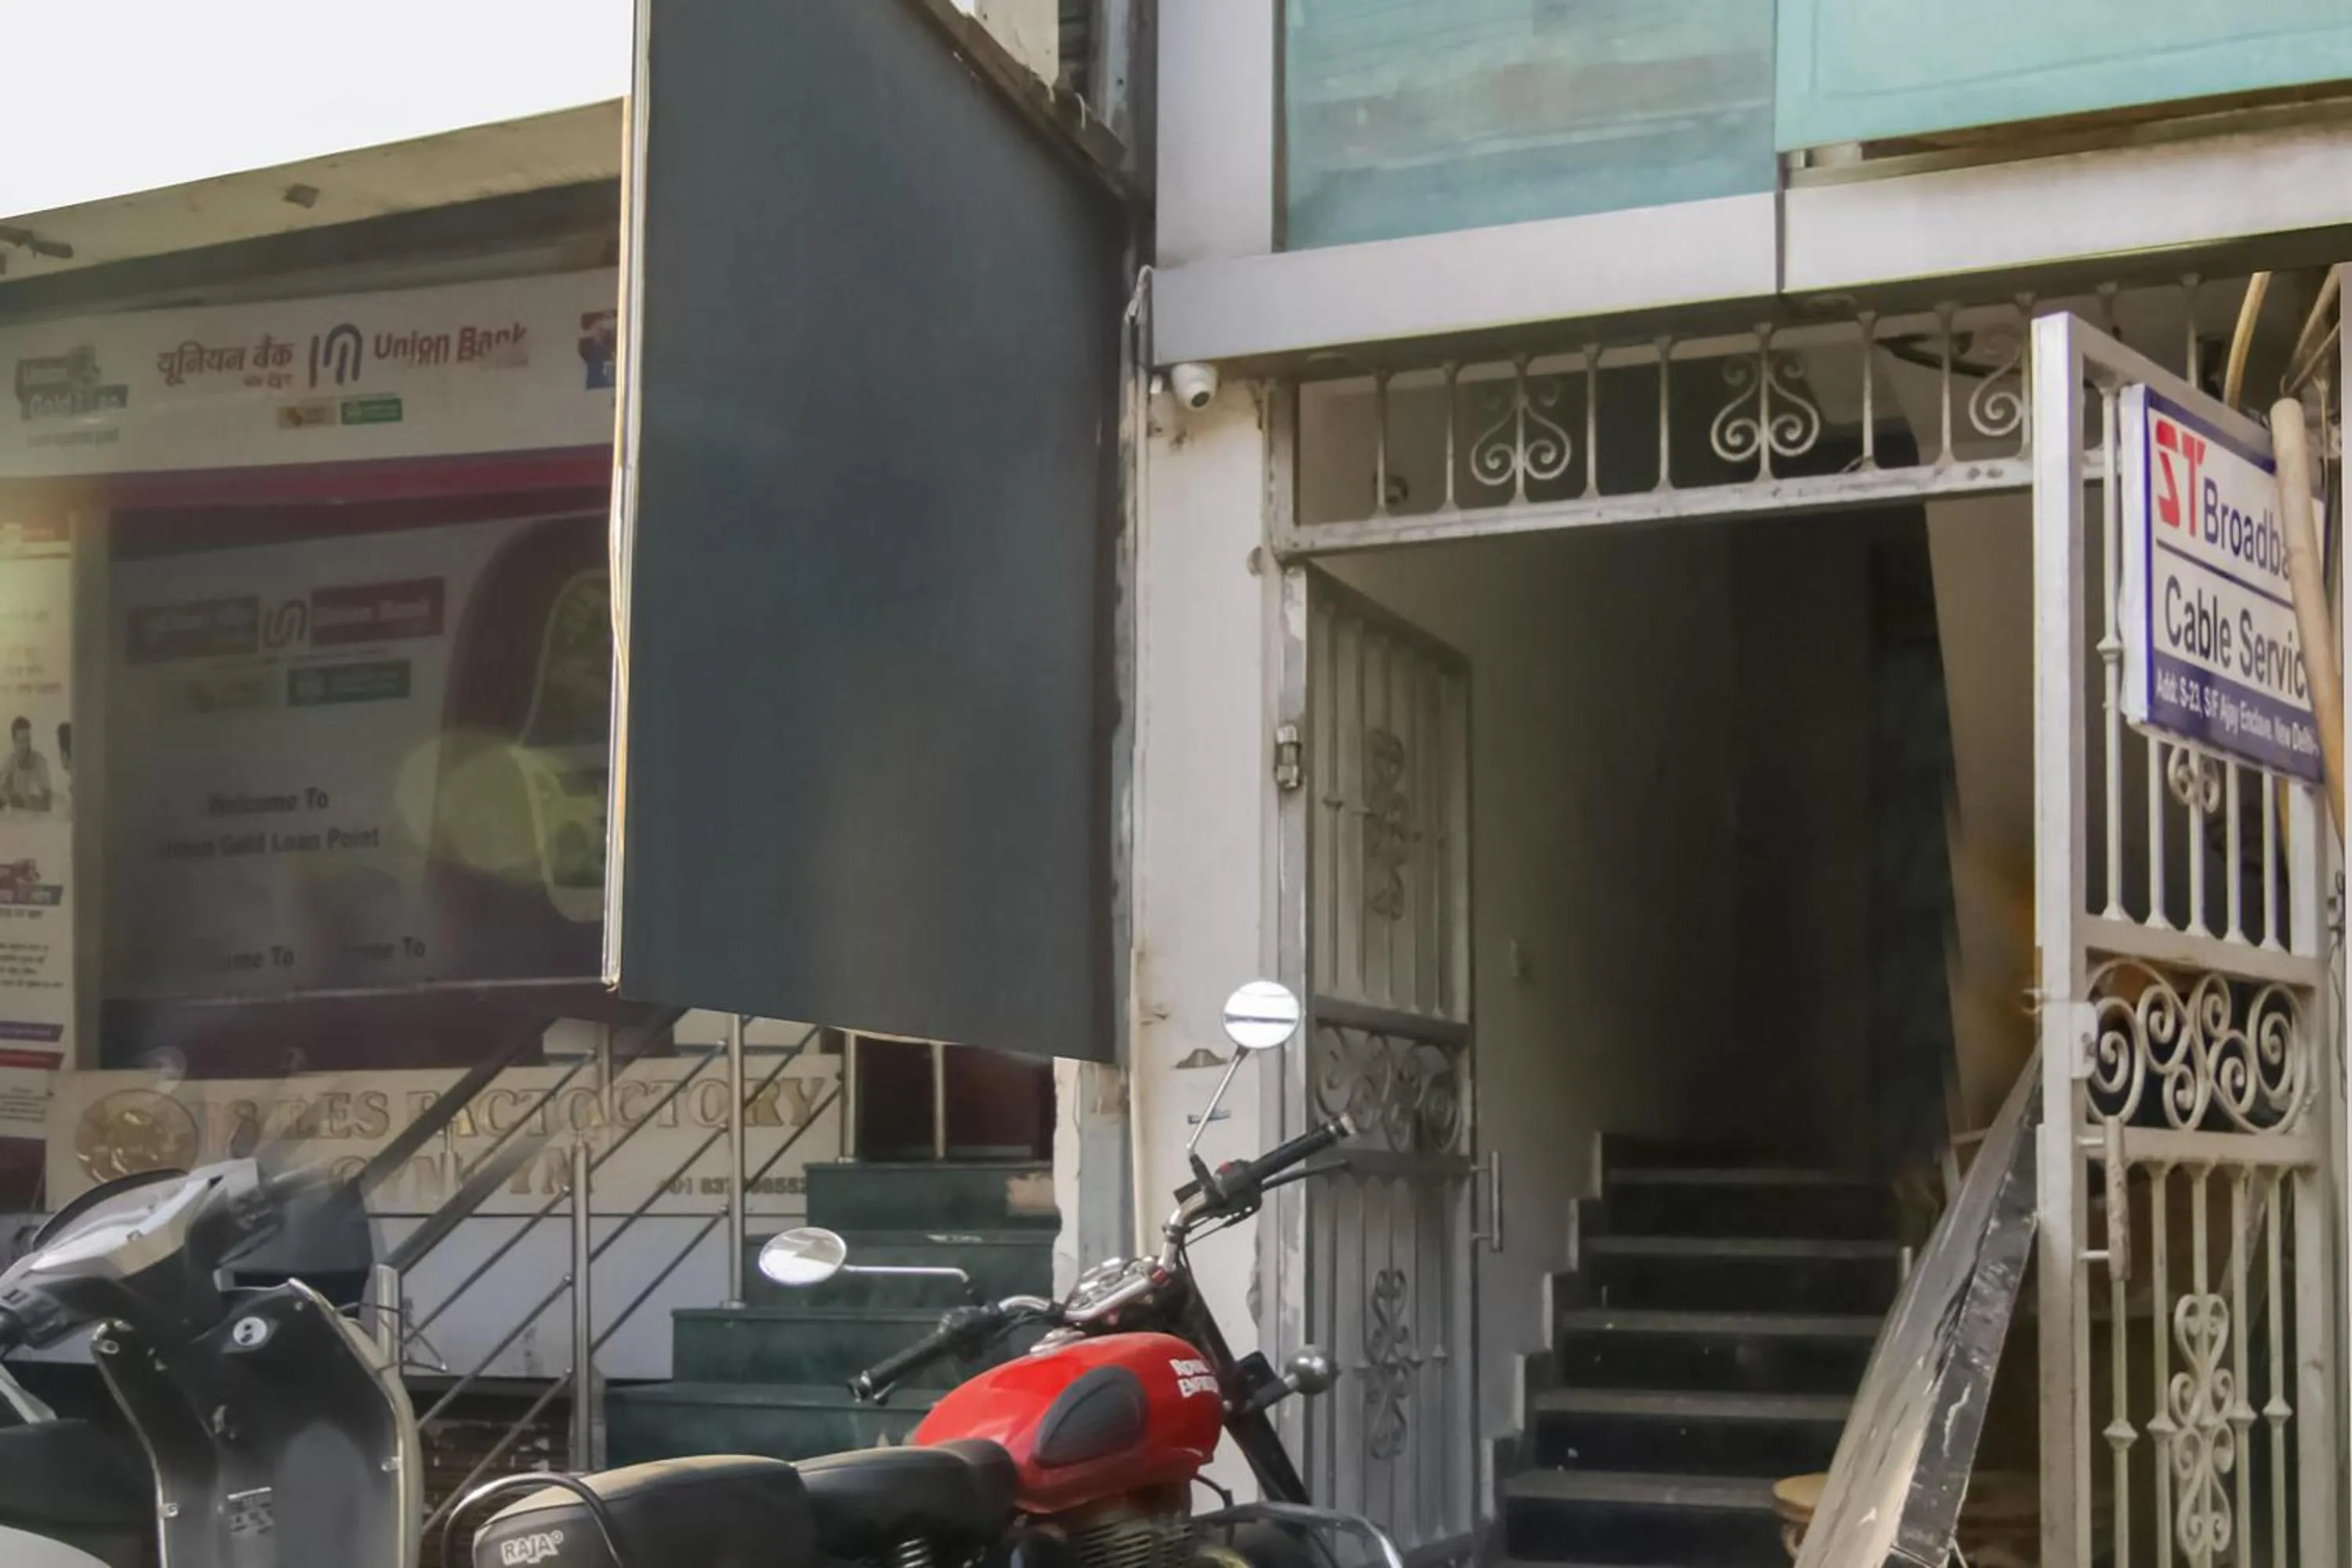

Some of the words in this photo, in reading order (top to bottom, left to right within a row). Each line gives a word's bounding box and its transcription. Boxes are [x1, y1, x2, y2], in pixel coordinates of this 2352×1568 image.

[2156, 419, 2205, 538] ST
[2204, 477, 2291, 580] Broadba
[2165, 574, 2232, 669] Cable
[2239, 608, 2307, 699] Servic
[305, 787, 329, 810] To
[502, 1533, 557, 1566] RAJA
